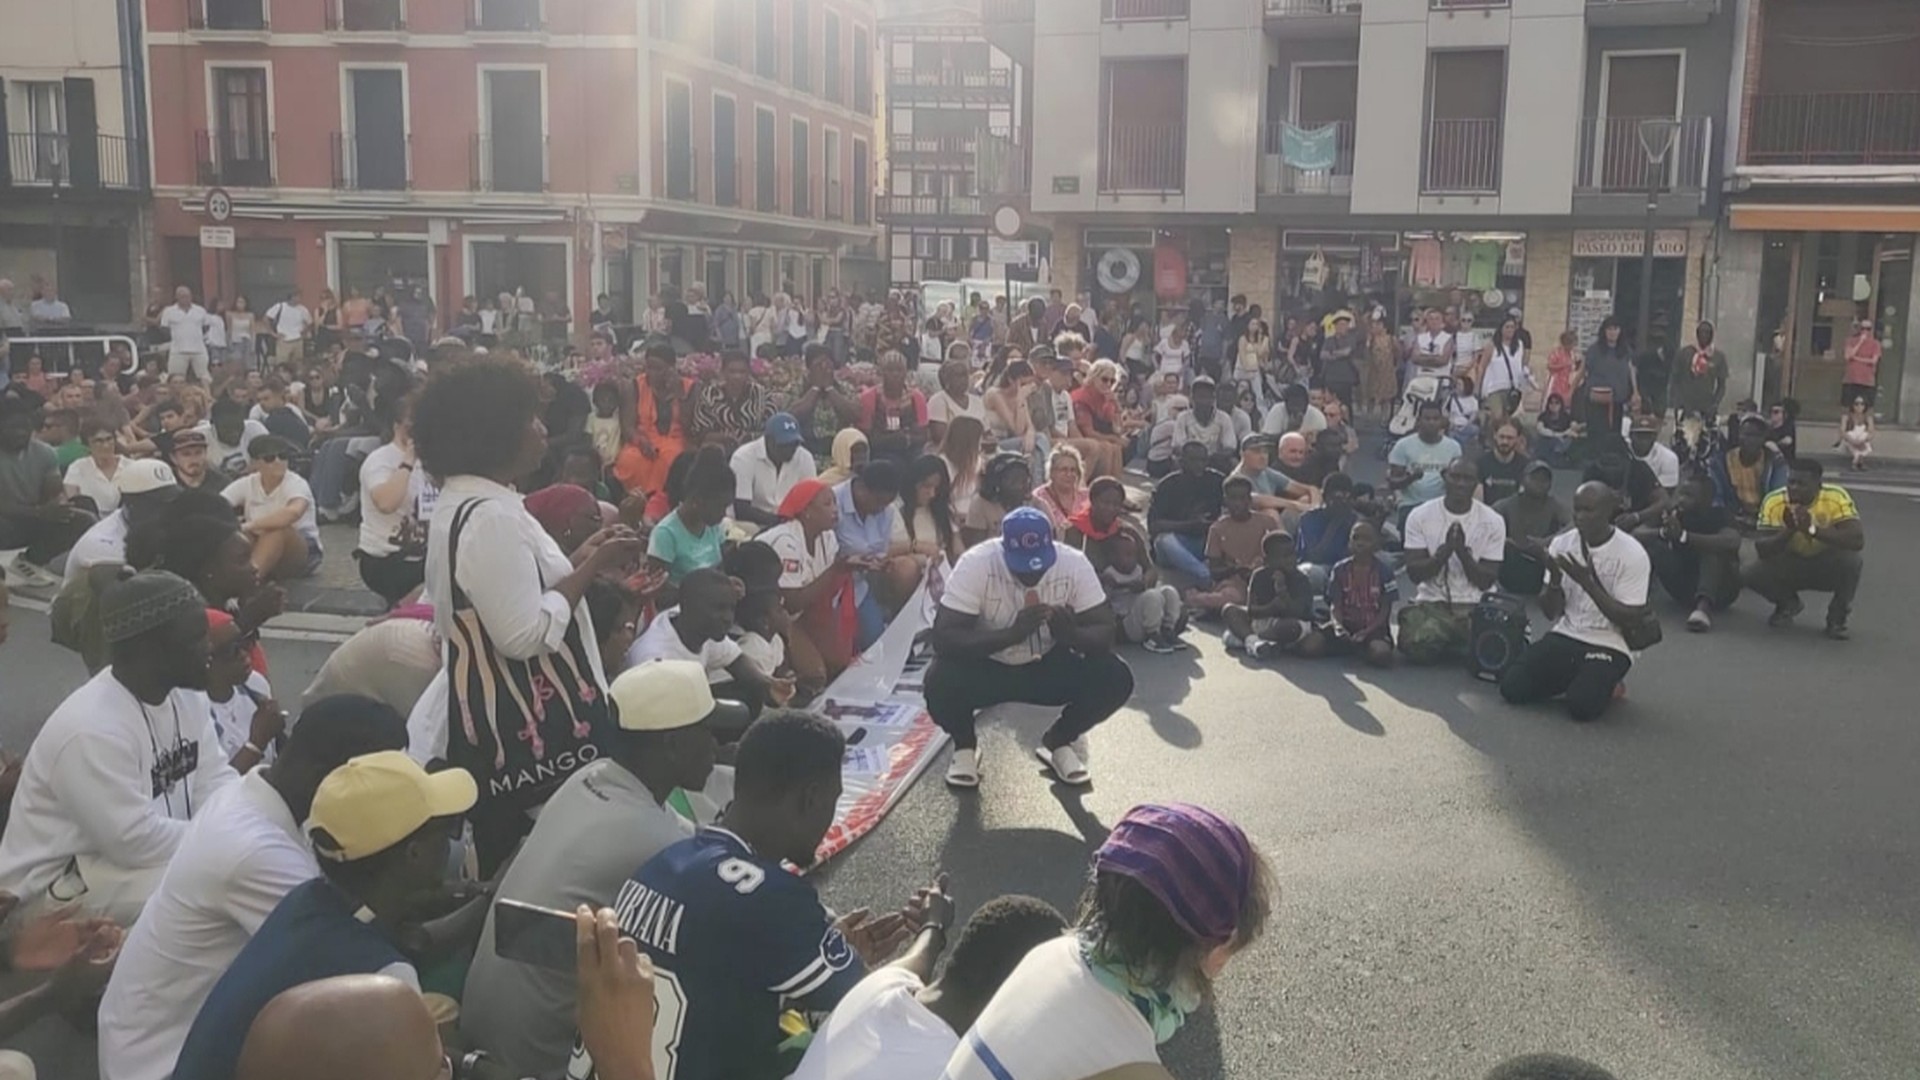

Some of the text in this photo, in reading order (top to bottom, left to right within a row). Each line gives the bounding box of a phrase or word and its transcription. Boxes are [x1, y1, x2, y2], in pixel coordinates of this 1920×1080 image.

[212, 200, 227, 213] 20
[1577, 242, 1618, 254] PASEO
[1653, 242, 1685, 254] ARO
[489, 743, 599, 797] MANGO
